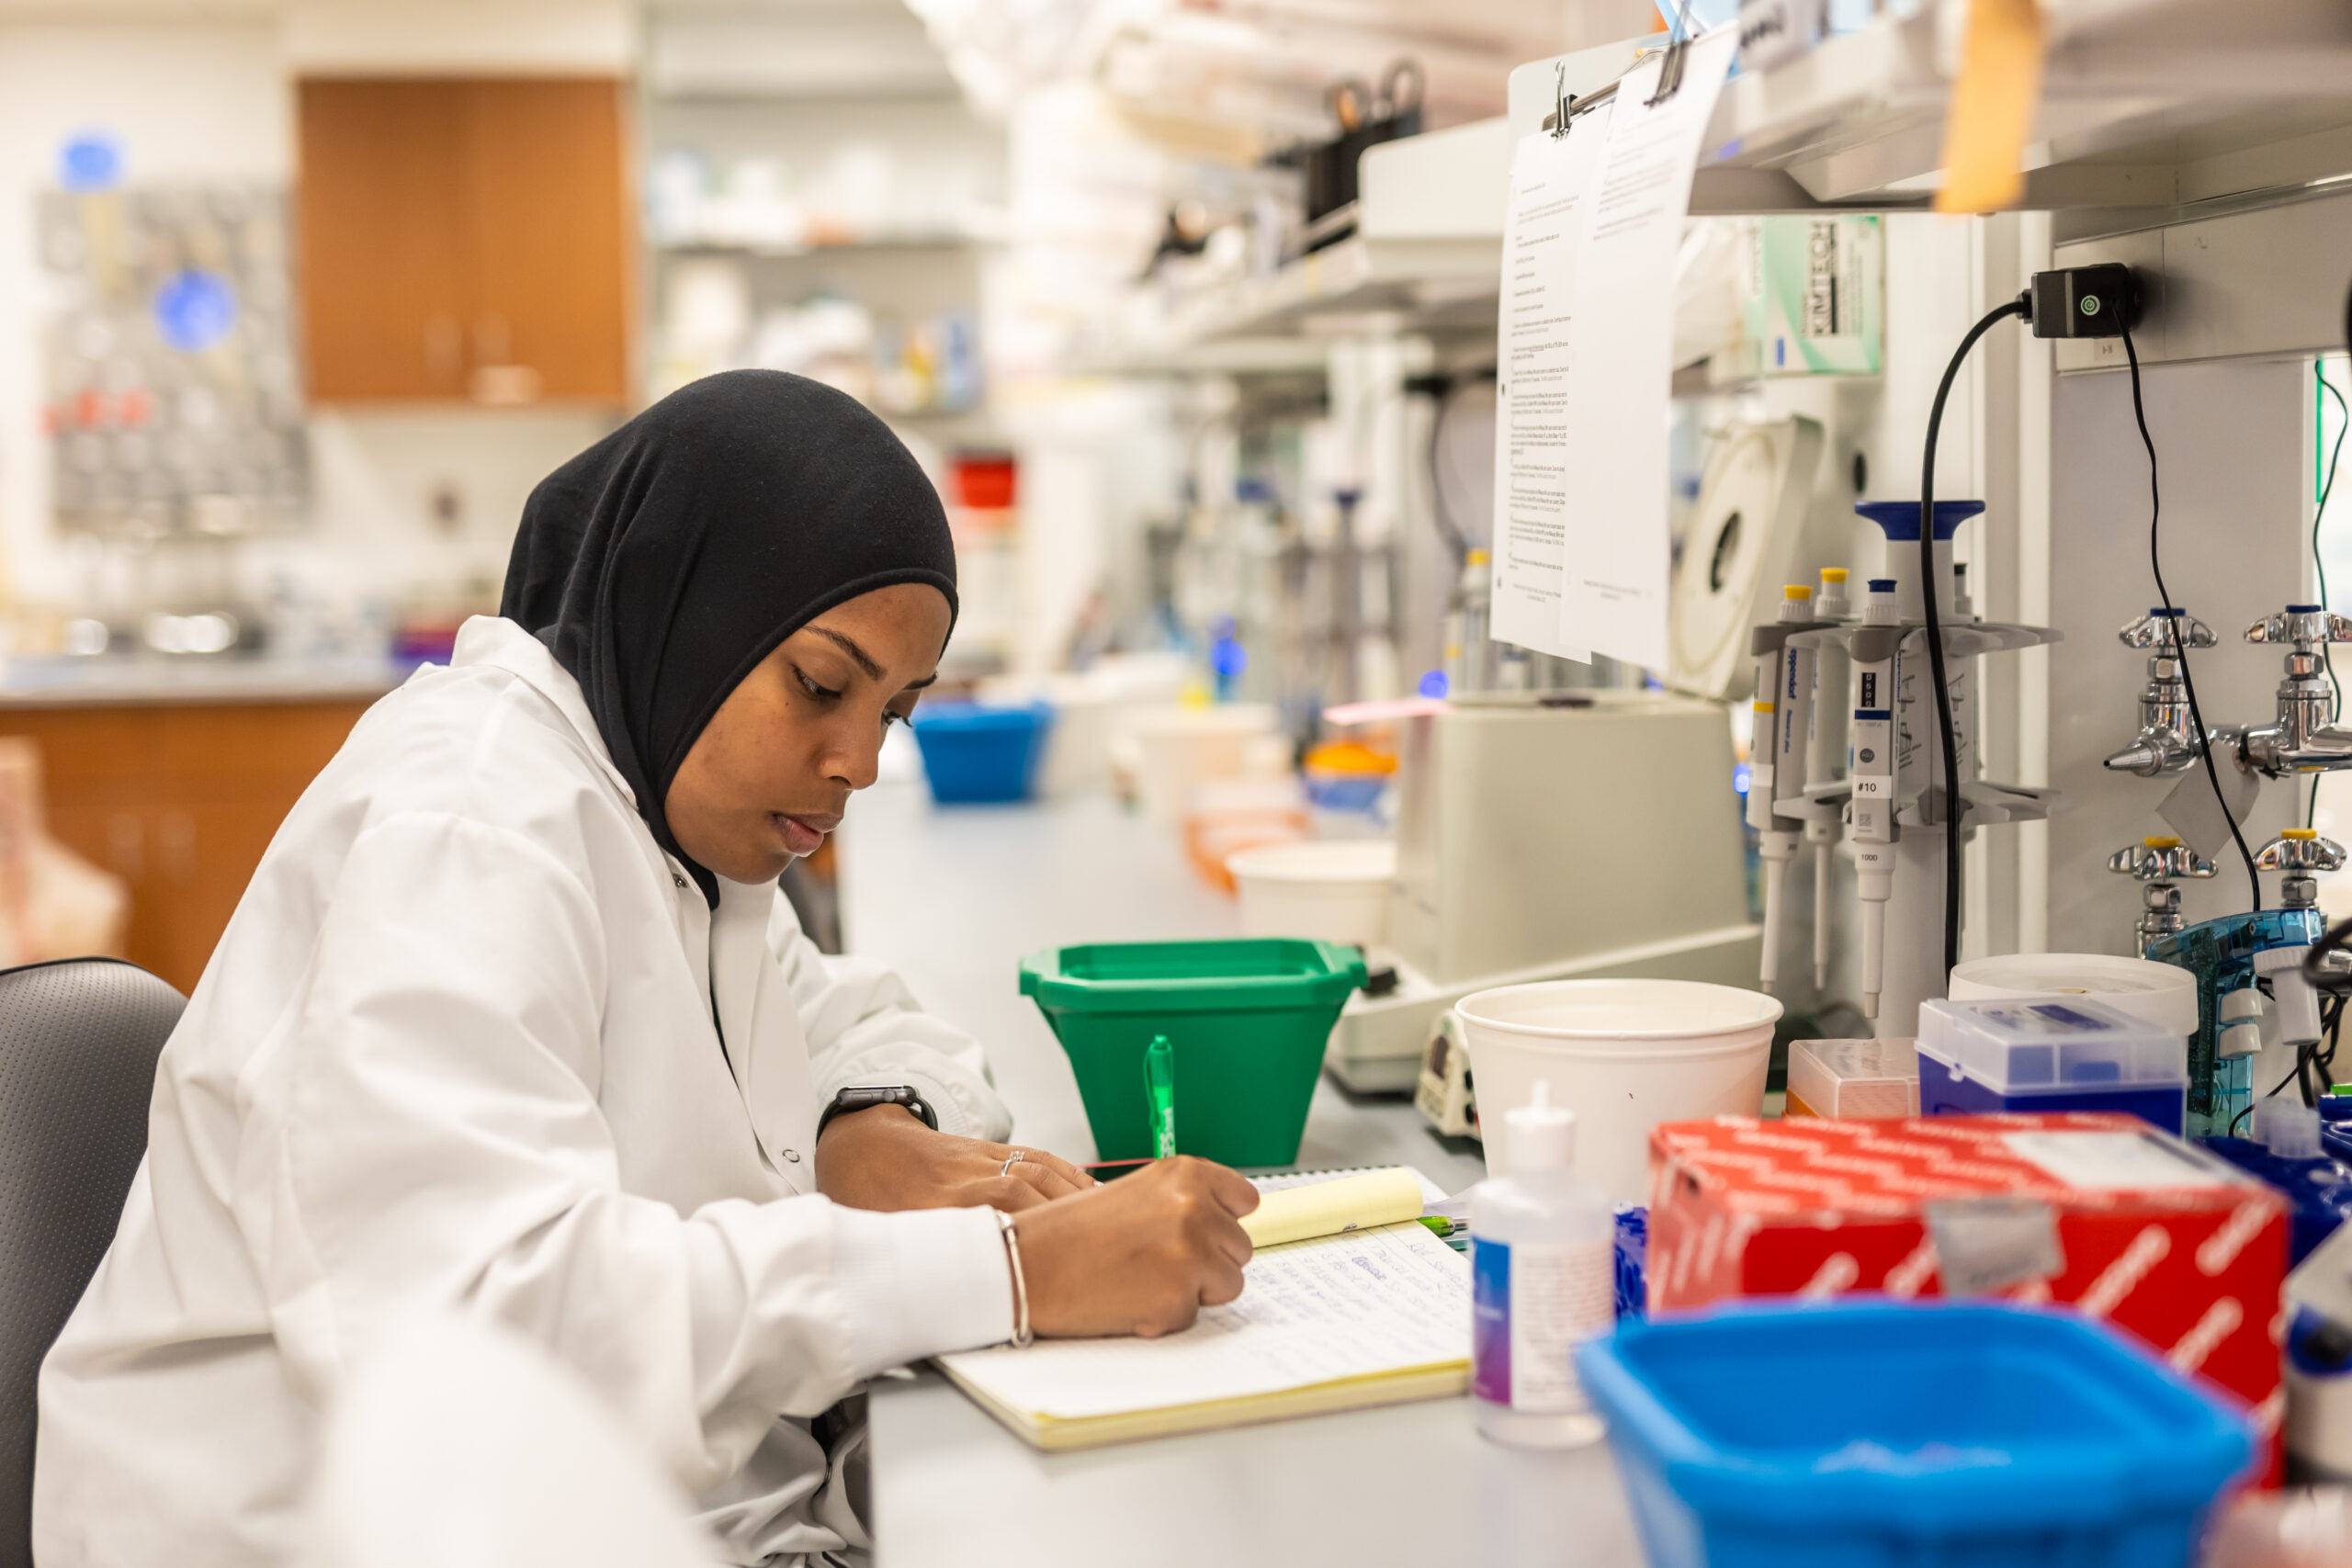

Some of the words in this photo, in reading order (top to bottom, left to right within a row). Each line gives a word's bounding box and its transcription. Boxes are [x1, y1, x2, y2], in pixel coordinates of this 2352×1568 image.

[1811, 222, 1831, 337] KIMTECH
[1788, 649, 1798, 700] eppendorf
[1858, 782, 1877, 793] #10
[1860, 853, 1878, 862] 1000
